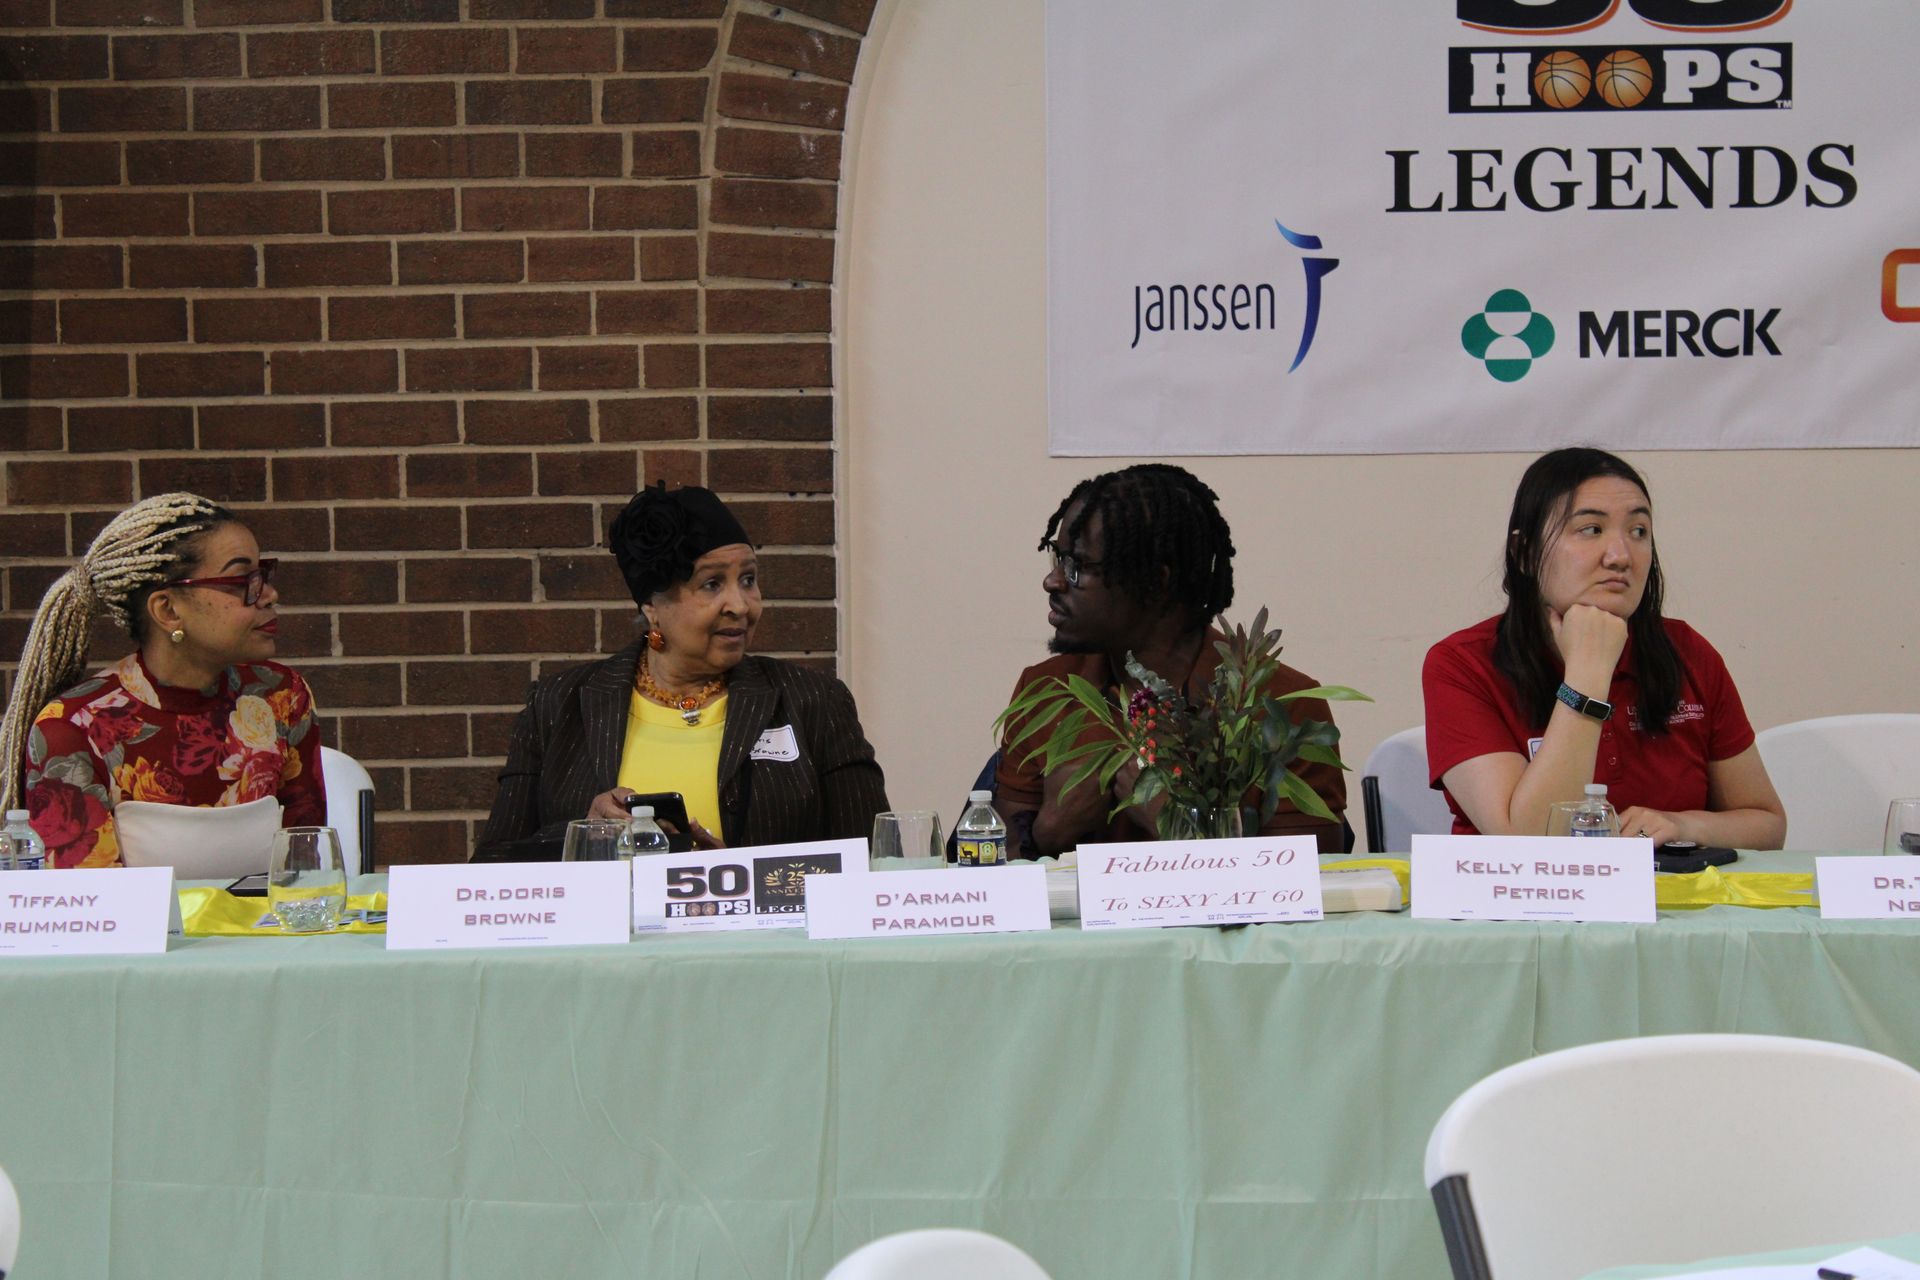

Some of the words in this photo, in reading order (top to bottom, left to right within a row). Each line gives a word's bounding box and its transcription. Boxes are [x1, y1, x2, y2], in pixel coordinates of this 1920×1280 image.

[1470, 48, 1784, 109] HOOPS
[1385, 144, 1858, 212] LEGENDS
[1579, 308, 1783, 358] MERCK
[1104, 854, 1239, 874] Fabulous
[1252, 849, 1295, 867] 50
[1456, 860, 1523, 875] KELLY
[1535, 862, 1620, 877] RUSSO-
[667, 864, 749, 899] 50
[9, 894, 99, 909] TIFFANY
[1101, 899, 1128, 911] To
[1138, 894, 1218, 910] SEXY
[1222, 891, 1266, 905] AT
[1272, 890, 1304, 903] 60
[1493, 886, 1585, 901] PETRICK
[0, 920, 117, 934] RUMMOND
[464, 912, 557, 926] BROWNE
[872, 915, 996, 930] PARAMOUR
